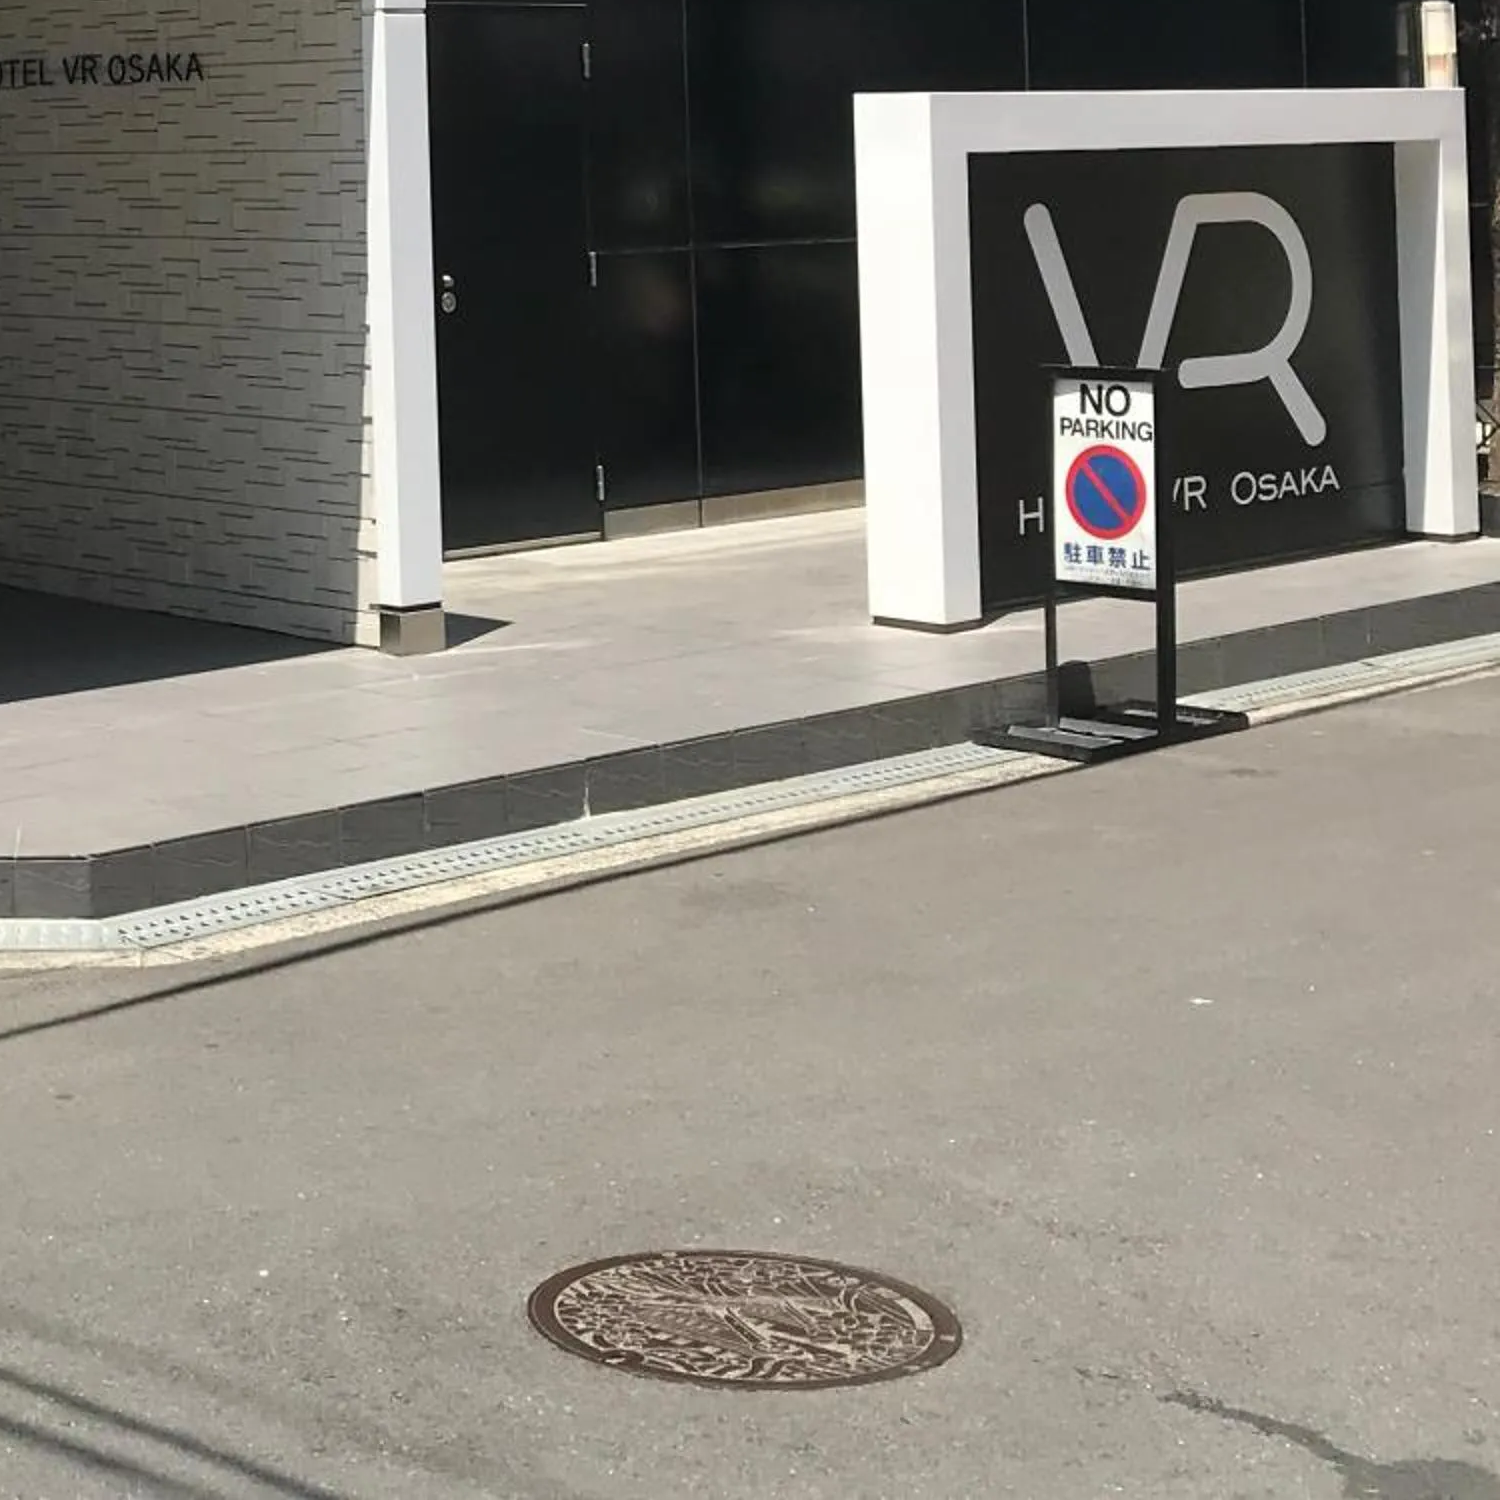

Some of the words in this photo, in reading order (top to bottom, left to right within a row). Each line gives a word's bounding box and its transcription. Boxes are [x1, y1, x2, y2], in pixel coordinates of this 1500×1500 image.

[62, 54, 98, 85] VR
[107, 52, 205, 85] OSAKA
[1023, 191, 1327, 447] VR
[1079, 383, 1131, 417] NO
[1059, 416, 1153, 442] PARKING
[1231, 465, 1340, 504] OSAKA
[1063, 542, 1151, 571] 駐車禁止
